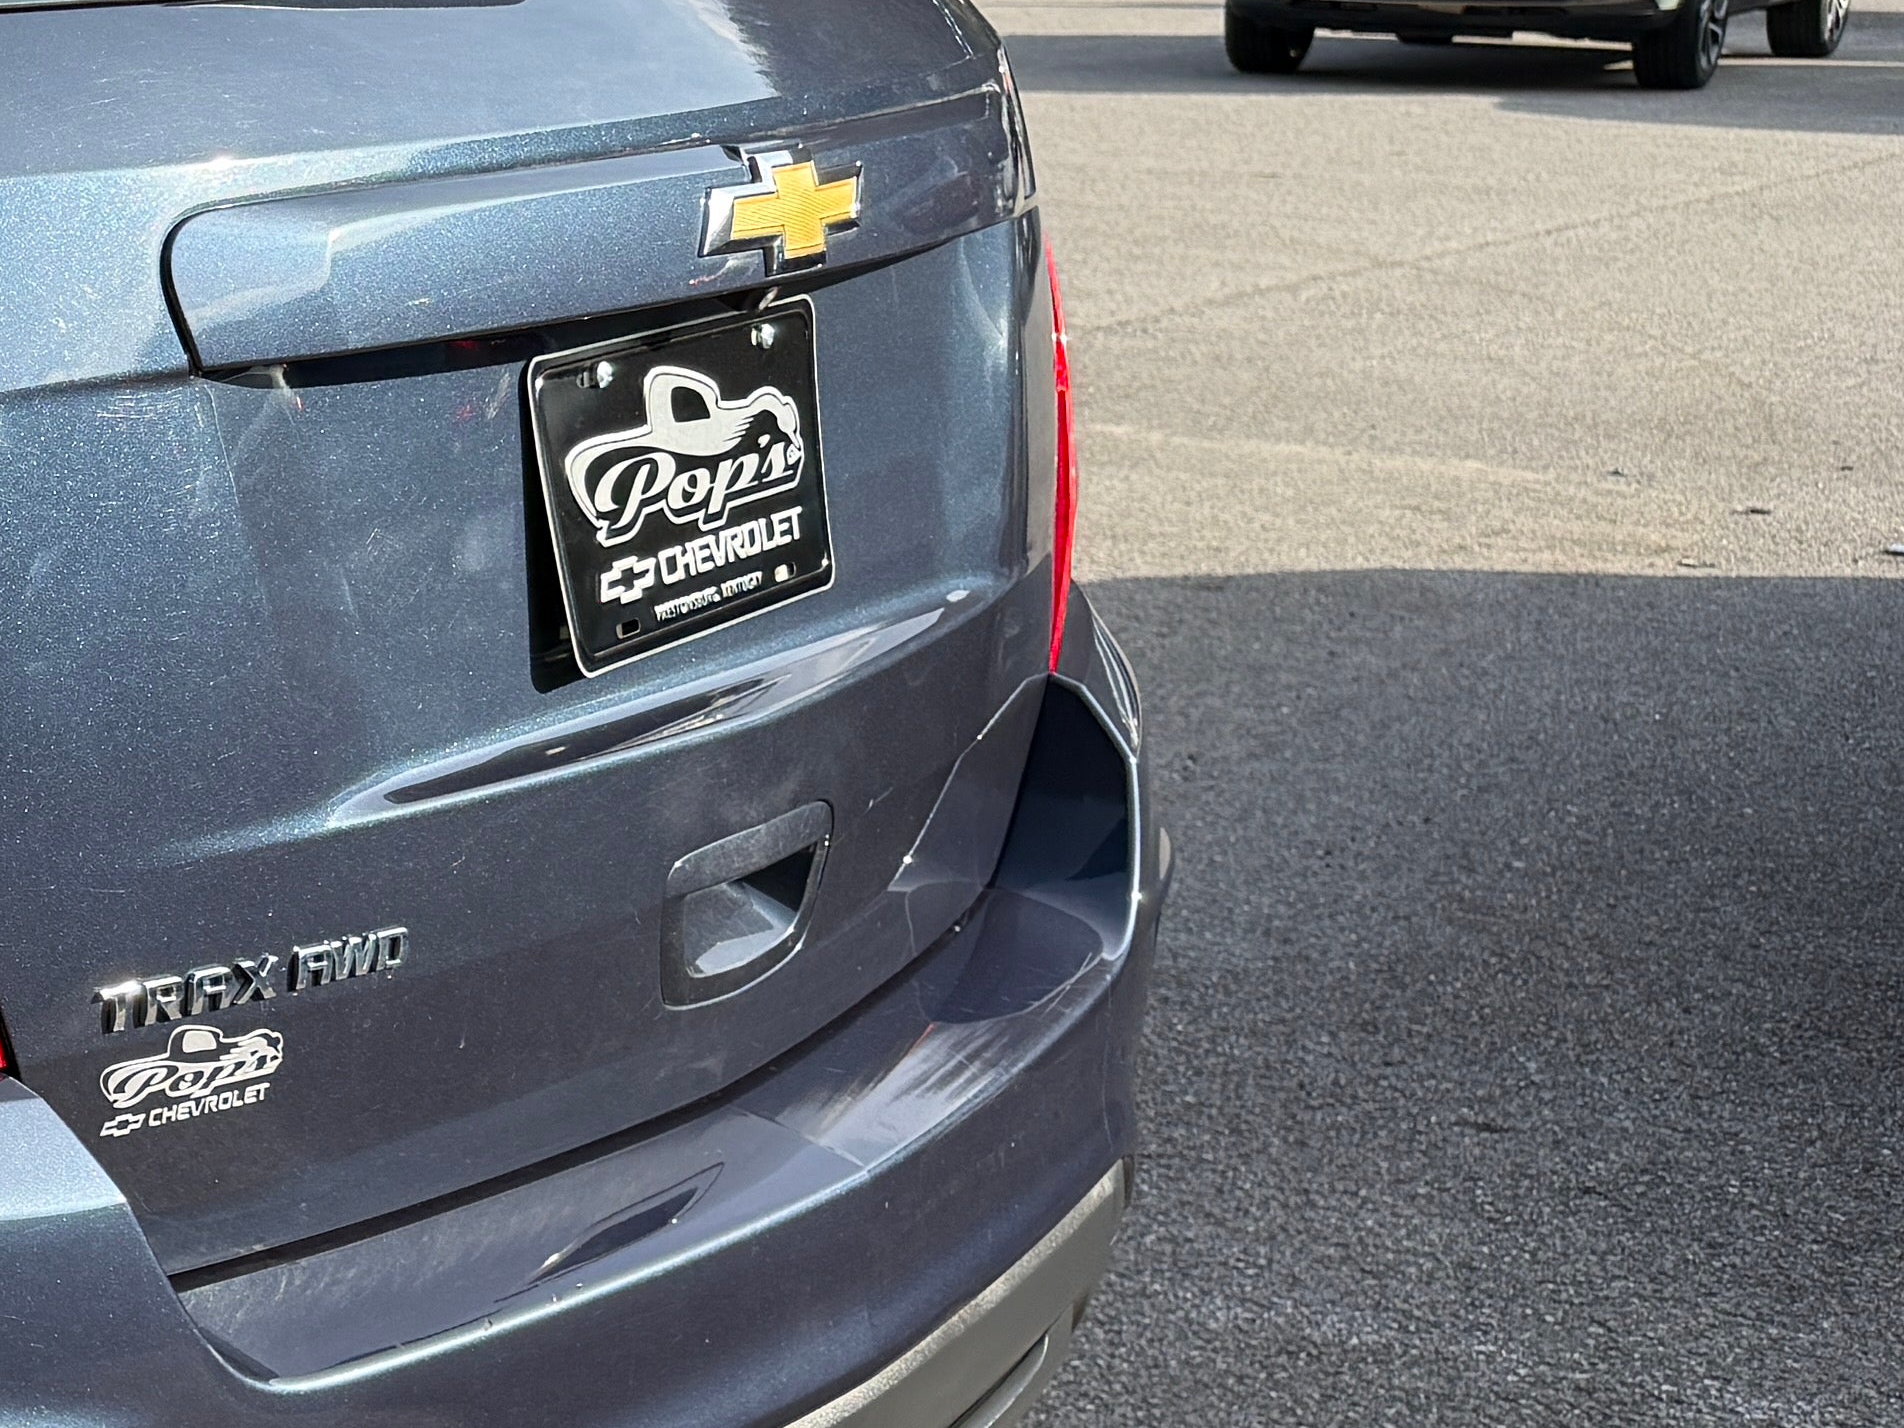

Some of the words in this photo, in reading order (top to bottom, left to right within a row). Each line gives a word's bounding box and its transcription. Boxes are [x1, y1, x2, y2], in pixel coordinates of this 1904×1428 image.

[593, 433, 794, 530] Pop's
[659, 506, 803, 586] CHEVROLET
[92, 952, 279, 1035] TRAX
[288, 925, 409, 994] AWD
[148, 1082, 271, 1127] CHEVROLET
